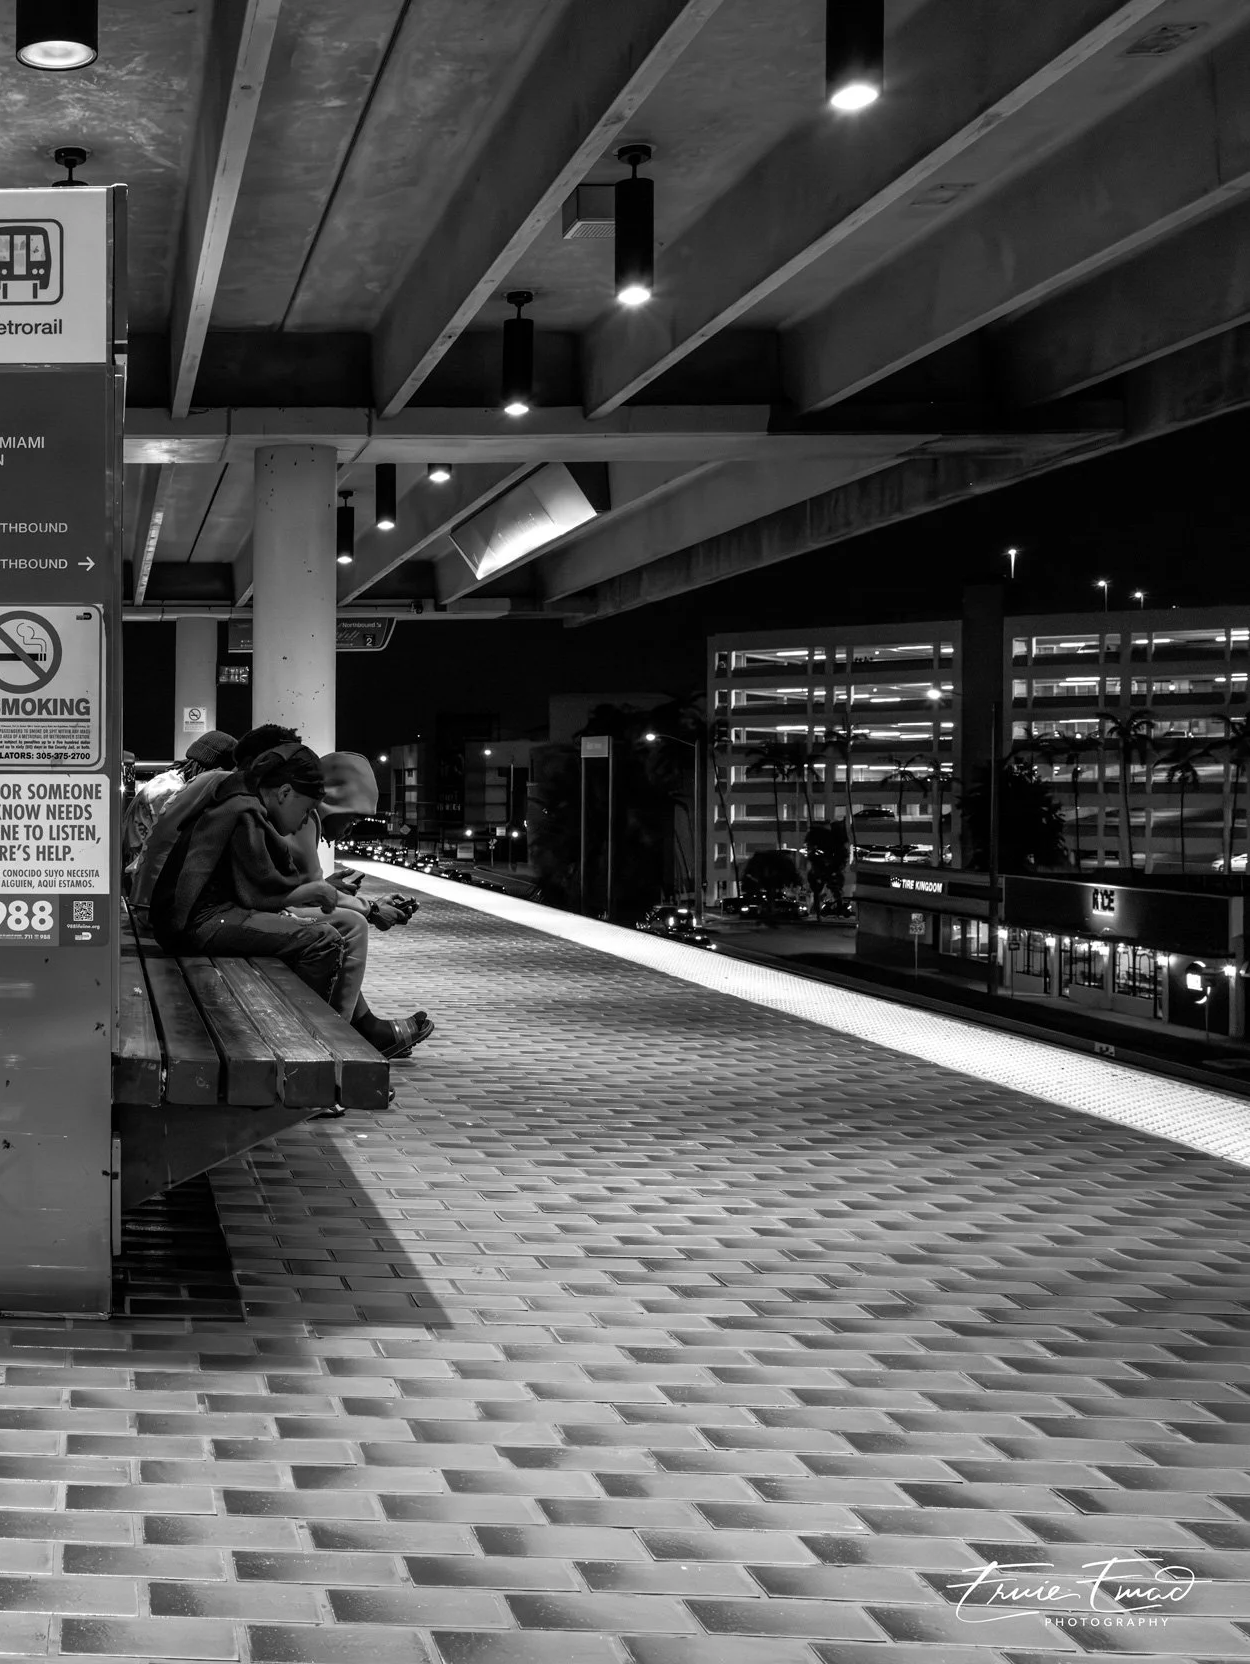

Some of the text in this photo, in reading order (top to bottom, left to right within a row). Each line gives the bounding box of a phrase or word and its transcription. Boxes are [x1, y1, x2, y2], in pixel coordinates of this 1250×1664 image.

[0, 436, 45, 449] MIAMI
[366, 637, 373, 646] 2
[36, 752, 91, 760] 305-375-2700
[0, 784, 22, 800] OR
[27, 784, 102, 800] SOMEONE
[46, 804, 93, 820] NEEDS
[23, 824, 44, 841] TO
[49, 824, 101, 844] LISTEN,
[36, 845, 74, 862] HELP.
[2, 869, 42, 878] CONOCIDO
[44, 869, 64, 878] SUYO
[67, 869, 100, 878] NECESITA
[1, 879, 35, 889] ALGUIEN,
[37, 878, 56, 888] AQUÍ
[58, 879, 95, 888] ESTAMOS.
[902, 879, 943, 893] TIRE KINGDOM
